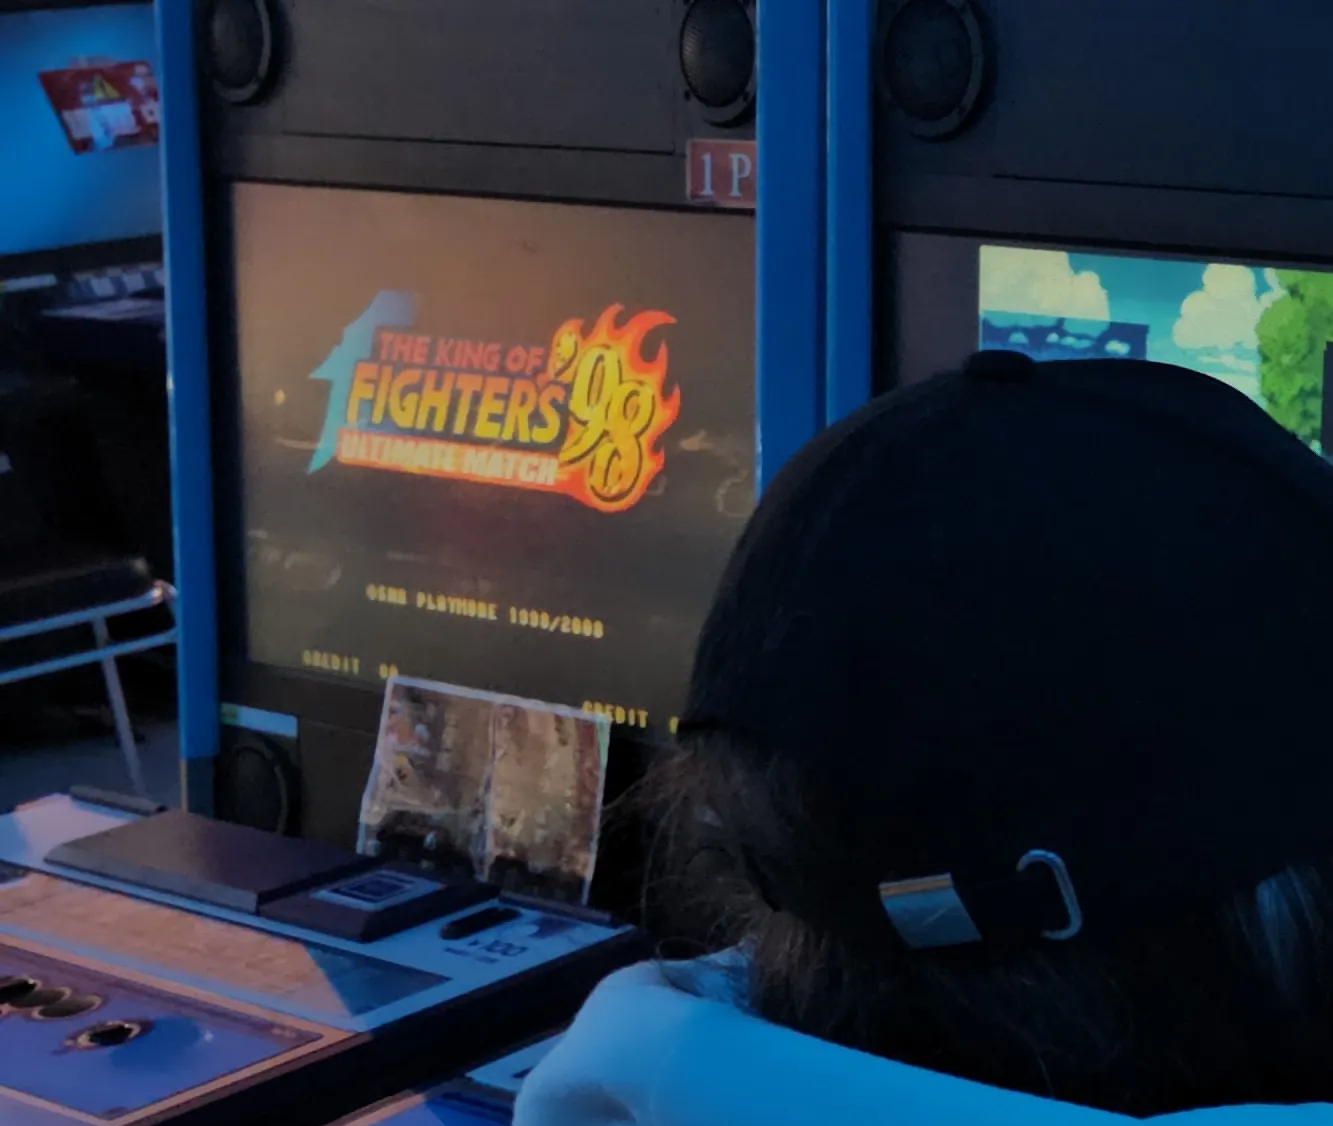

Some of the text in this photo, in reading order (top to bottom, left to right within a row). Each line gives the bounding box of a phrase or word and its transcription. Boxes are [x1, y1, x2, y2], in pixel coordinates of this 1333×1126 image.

[379, 332, 545, 376] THE KING OF
[347, 362, 566, 444] FIGHTERS
[341, 434, 559, 485] ULTIMATE MATCH
